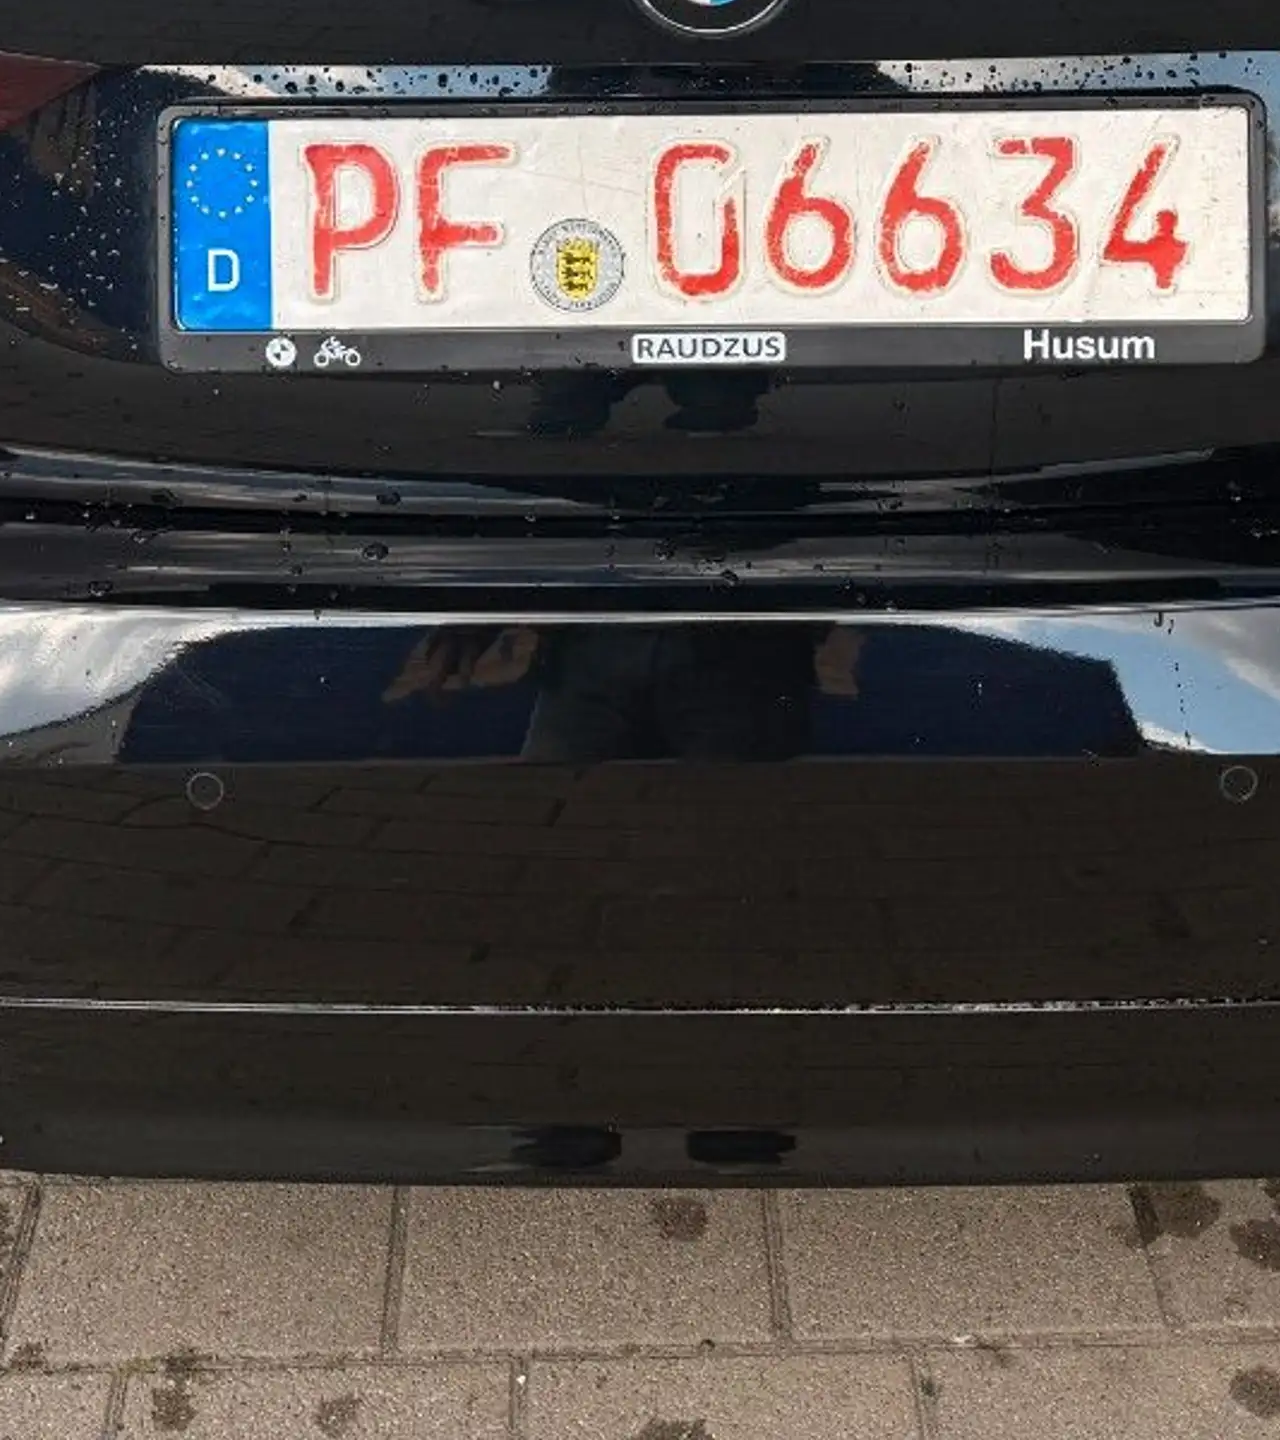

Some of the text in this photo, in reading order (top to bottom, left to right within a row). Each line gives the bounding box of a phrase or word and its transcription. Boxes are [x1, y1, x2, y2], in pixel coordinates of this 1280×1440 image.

[302, 140, 513, 298] PF
[653, 137, 1188, 296] 06634
[208, 248, 240, 292] D
[636, 337, 781, 359] RAUDZUS
[1023, 328, 1156, 360] Husum
